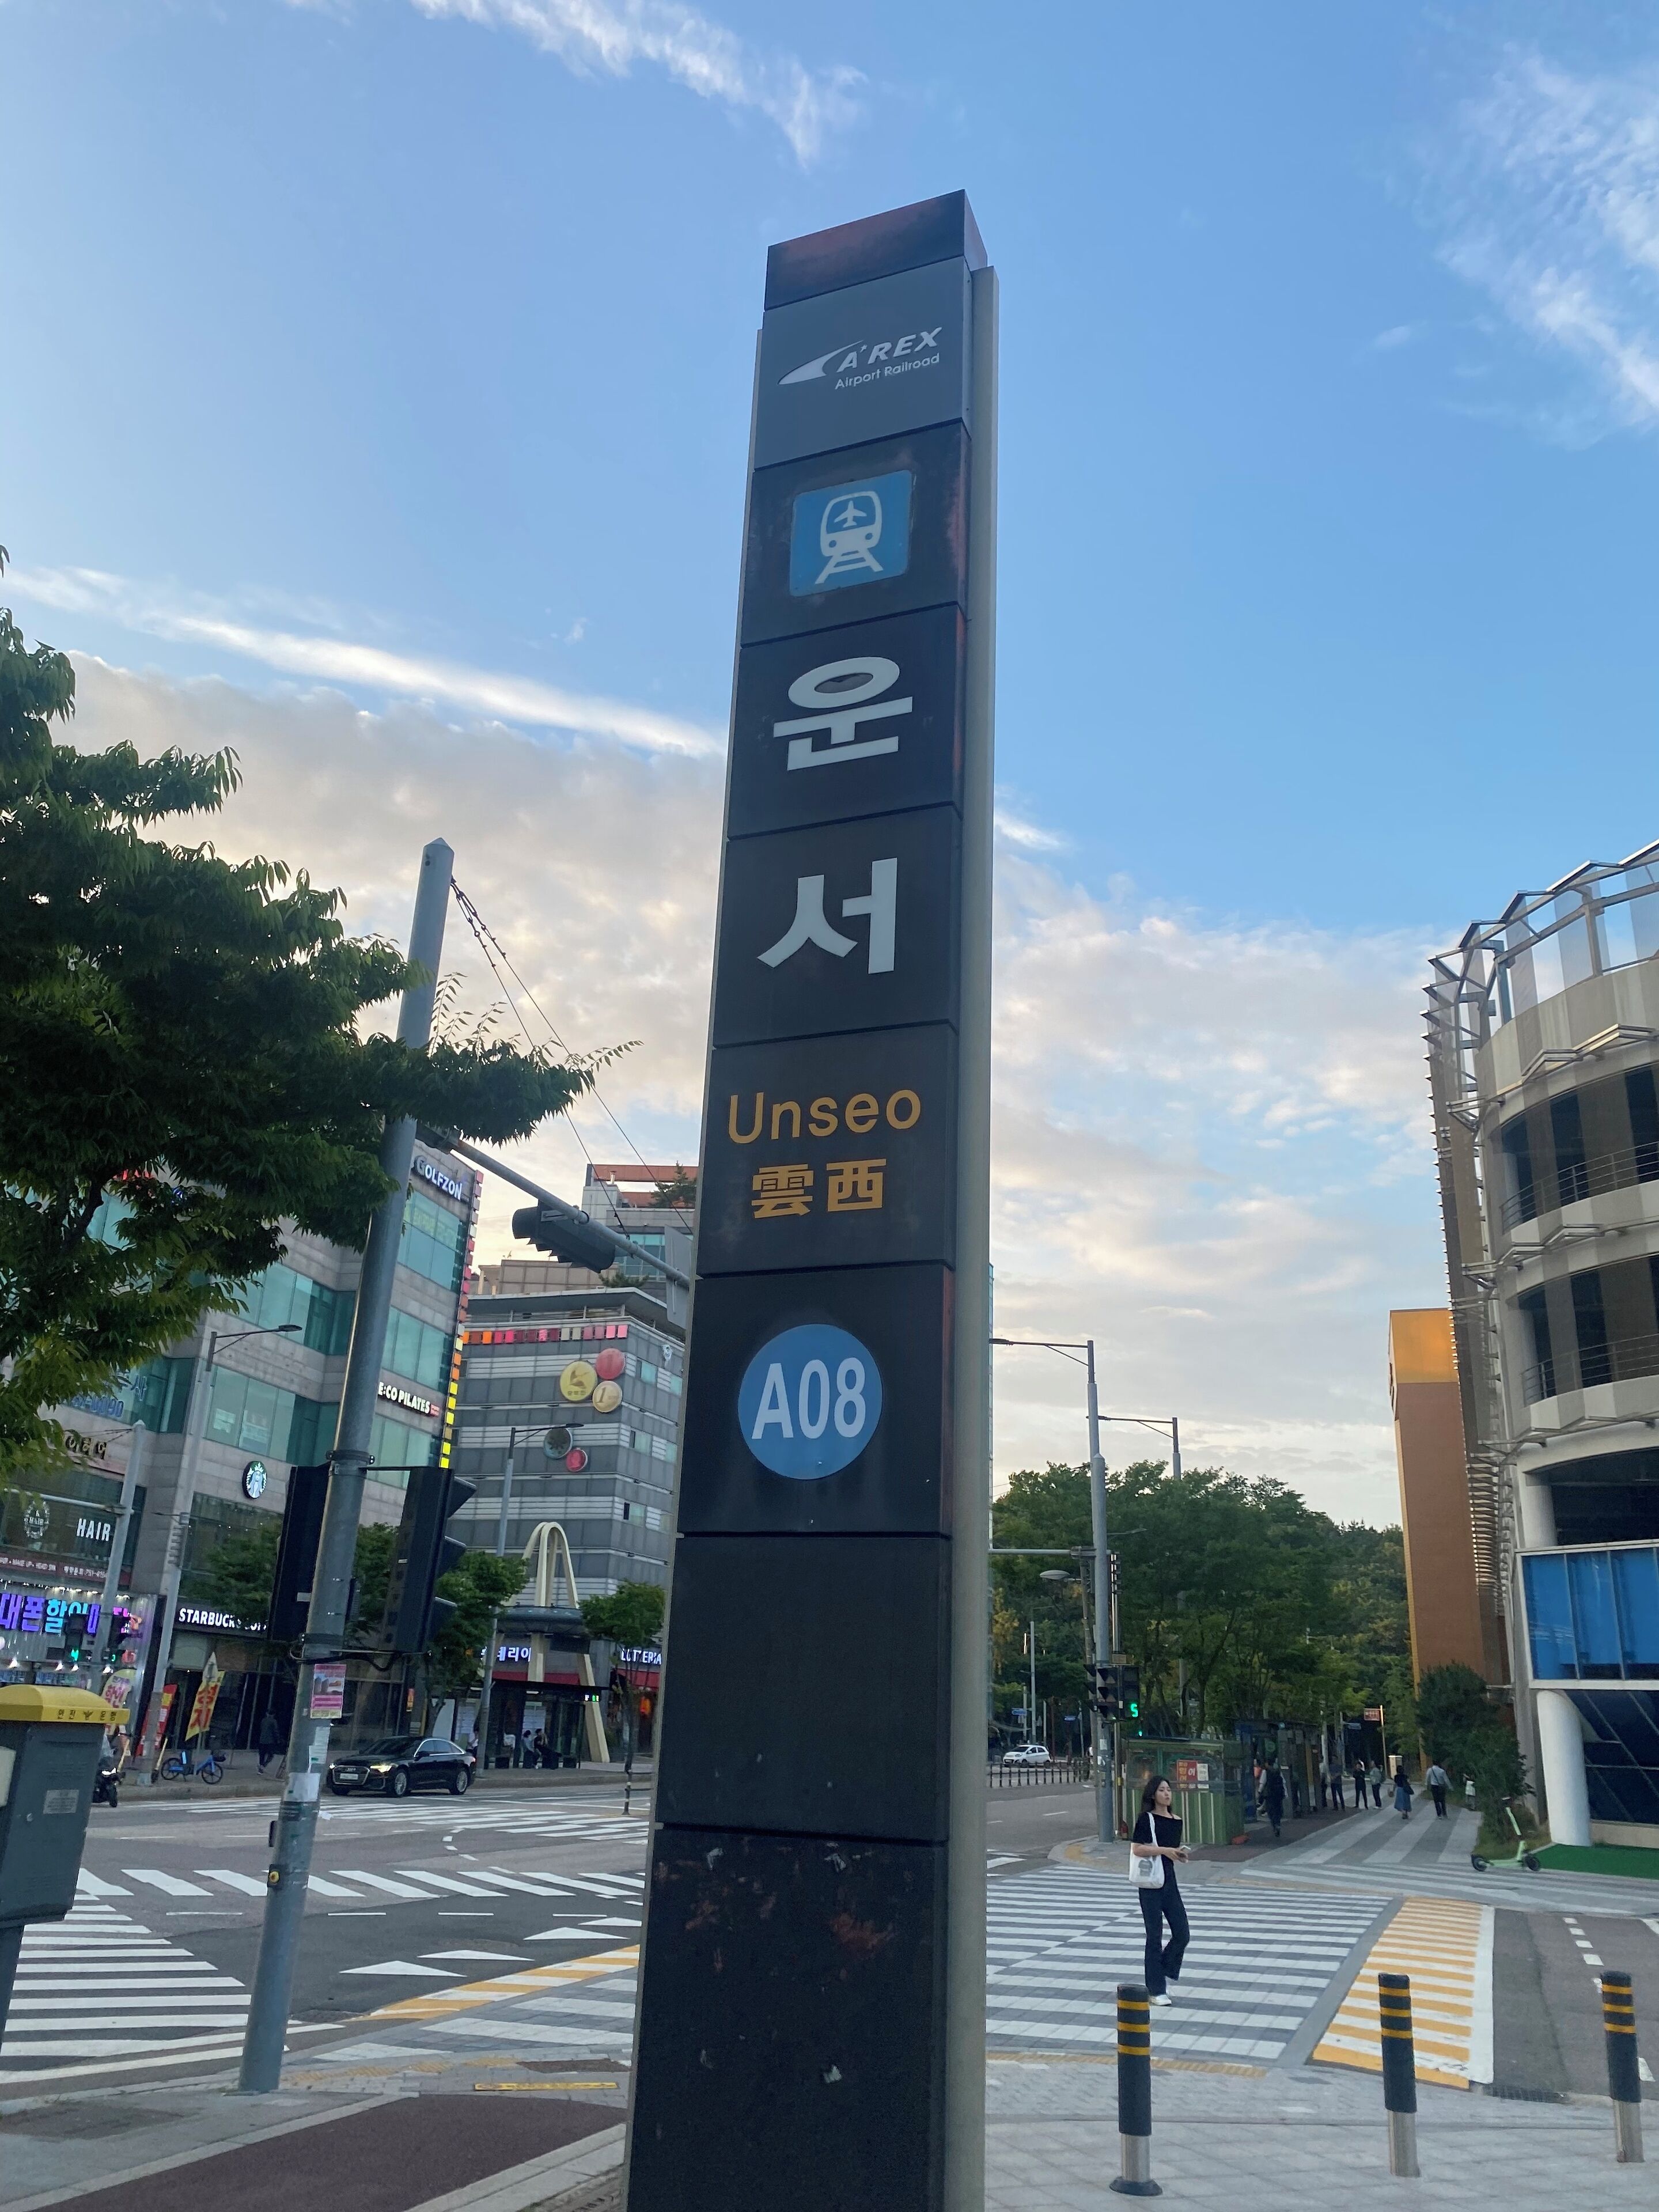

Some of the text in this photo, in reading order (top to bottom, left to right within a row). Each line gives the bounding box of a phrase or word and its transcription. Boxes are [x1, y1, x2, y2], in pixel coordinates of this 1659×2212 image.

[835, 353, 940, 389] Airport Railroad
[729, 1089, 921, 1144] Unseo
[415, 1156, 463, 1200] GOLFZON
[751, 1158, 887, 1219] 雲西
[398, 1389, 430, 1414] PILATES
[751, 1357, 866, 1440] A08
[76, 1518, 111, 1541] HAIR
[179, 1608, 241, 1628] STARBUCK
